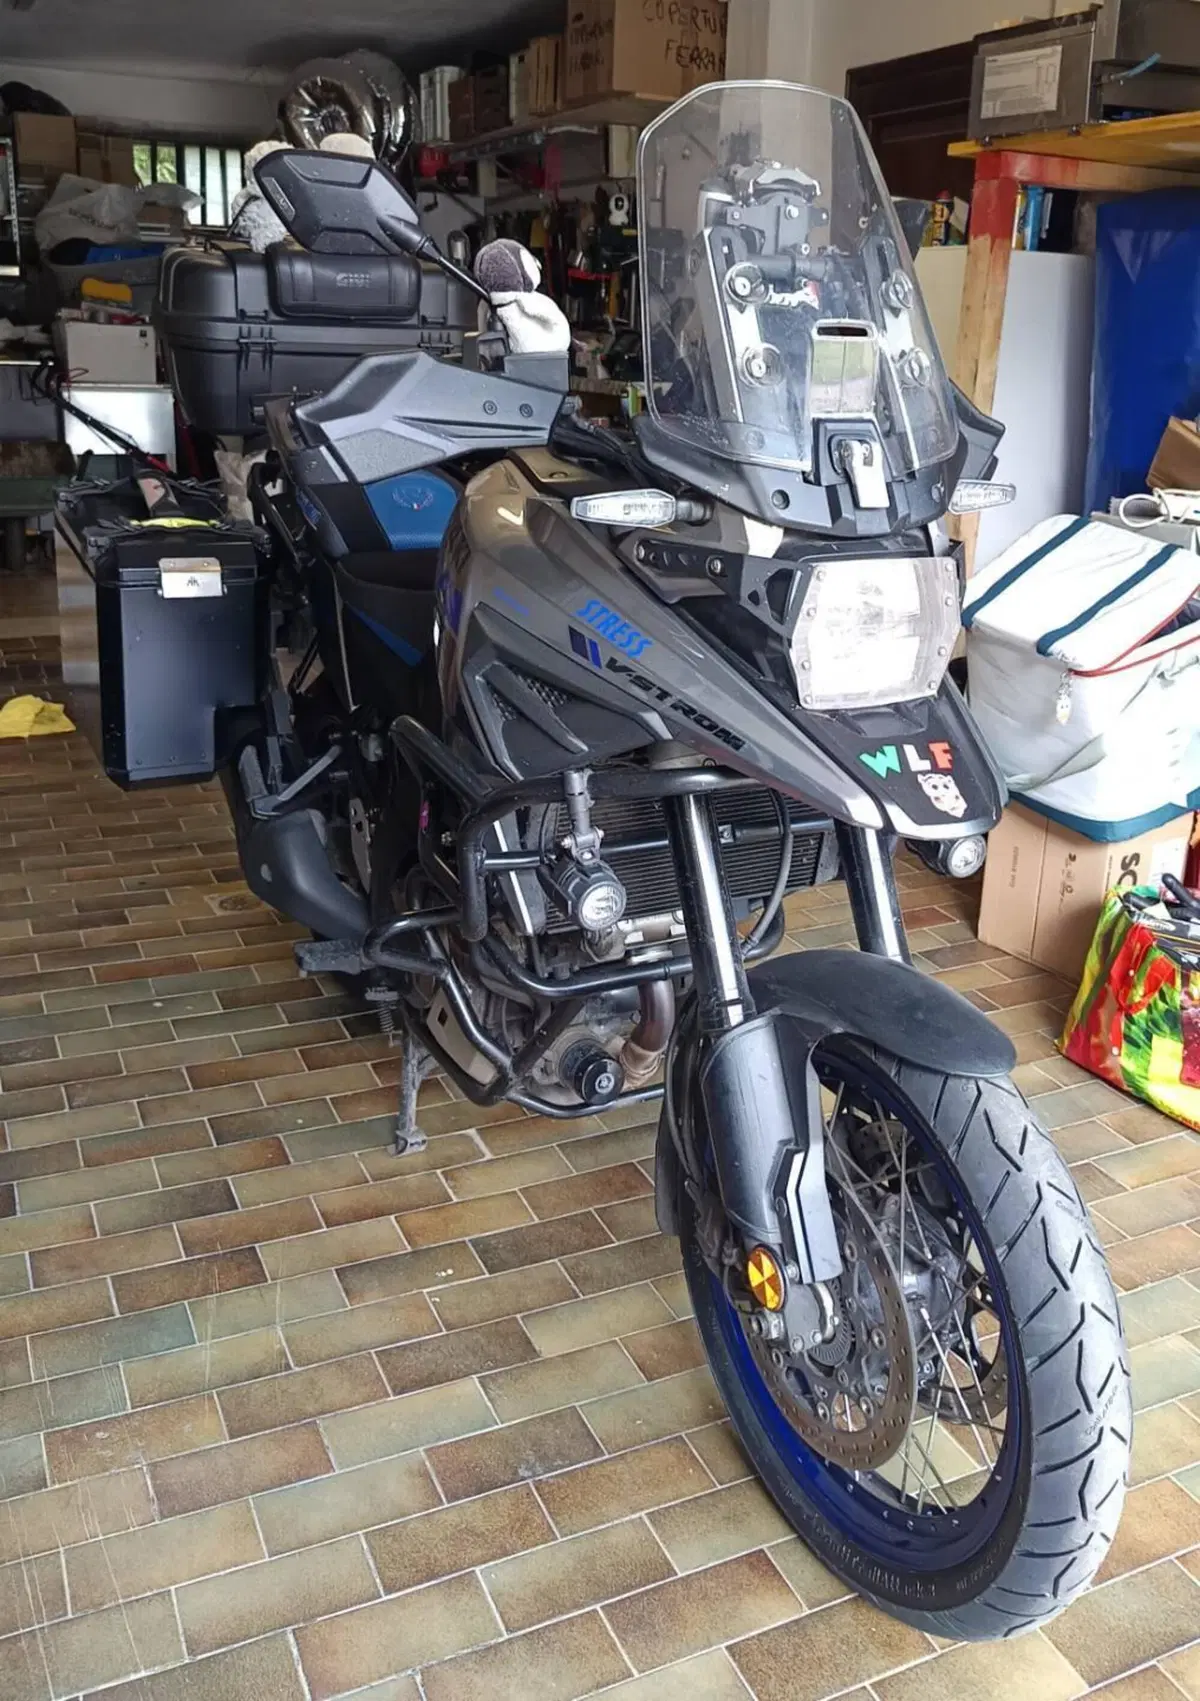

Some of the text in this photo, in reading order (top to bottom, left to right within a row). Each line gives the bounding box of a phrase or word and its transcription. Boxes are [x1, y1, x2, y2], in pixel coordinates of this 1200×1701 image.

[575, 599, 655, 661] STRESS
[605, 656, 747, 752] V-STROM
[857, 740, 954, 780] WLF
